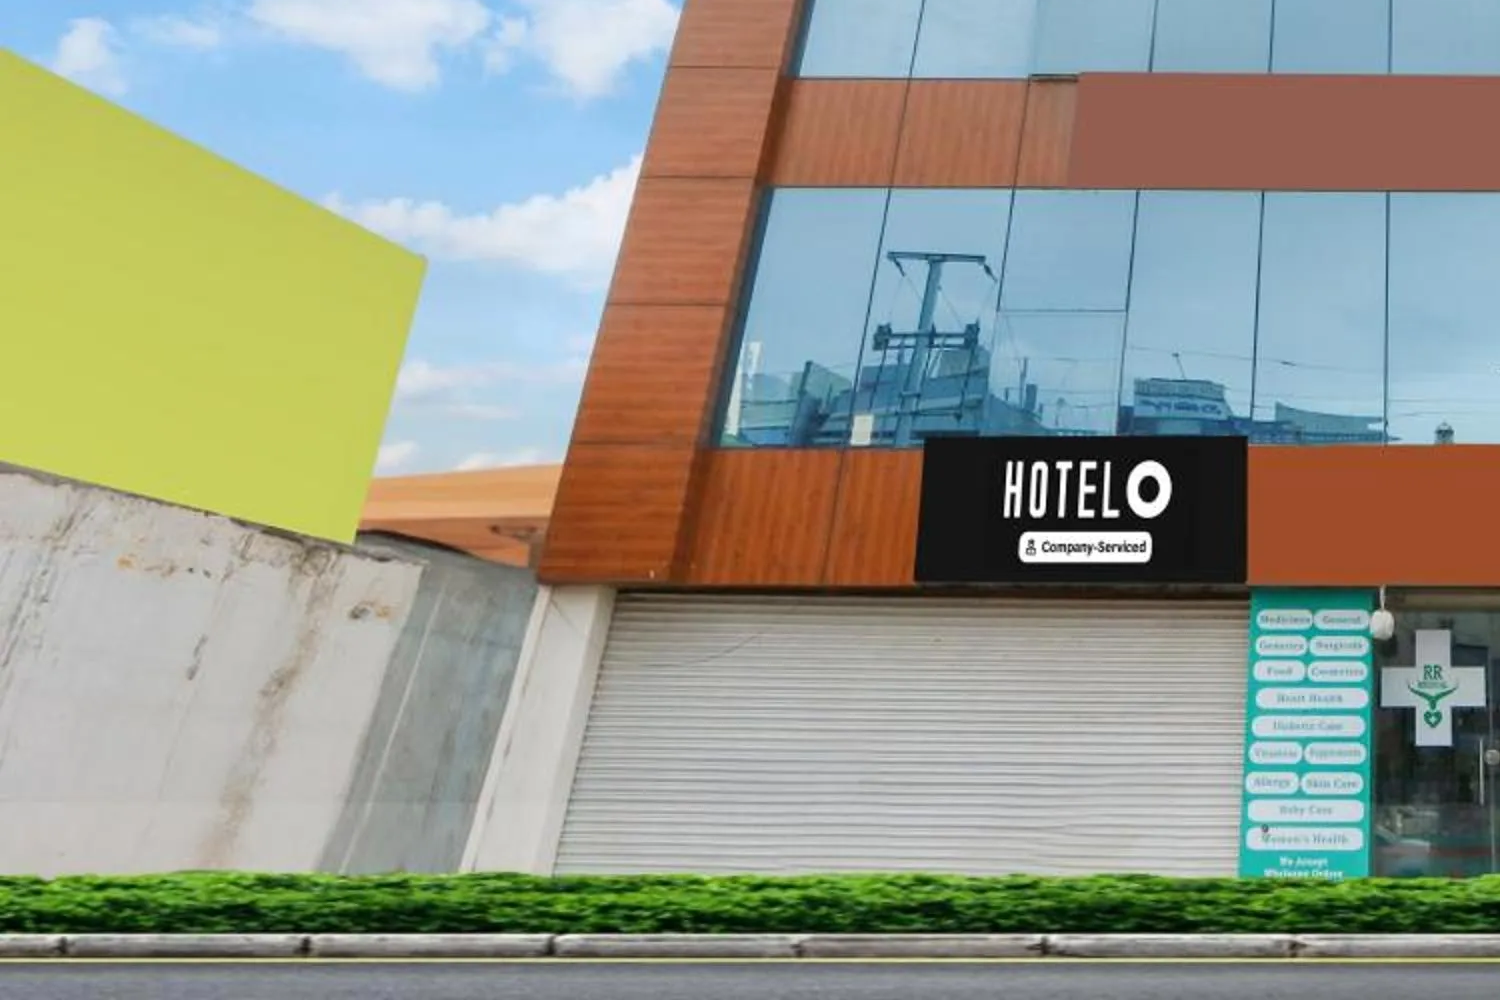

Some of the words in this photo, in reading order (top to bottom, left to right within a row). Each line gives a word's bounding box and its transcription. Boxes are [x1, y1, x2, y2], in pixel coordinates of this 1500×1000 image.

[1003, 460, 1120, 519] HOTEL
[1041, 540, 1147, 557] Company-Serviced
[1267, 665, 1294, 676] Food
[1423, 664, 1443, 681] RR
[1276, 693, 1305, 703] Heart
[1309, 693, 1343, 703] Health
[1319, 721, 1344, 731] Care
[1253, 776, 1291, 789] Allergy
[1306, 778, 1331, 789] Skin
[1333, 777, 1357, 789] Care
[1279, 805, 1304, 816] Baby
[1309, 805, 1333, 815] Care
[1313, 832, 1349, 844] Health
